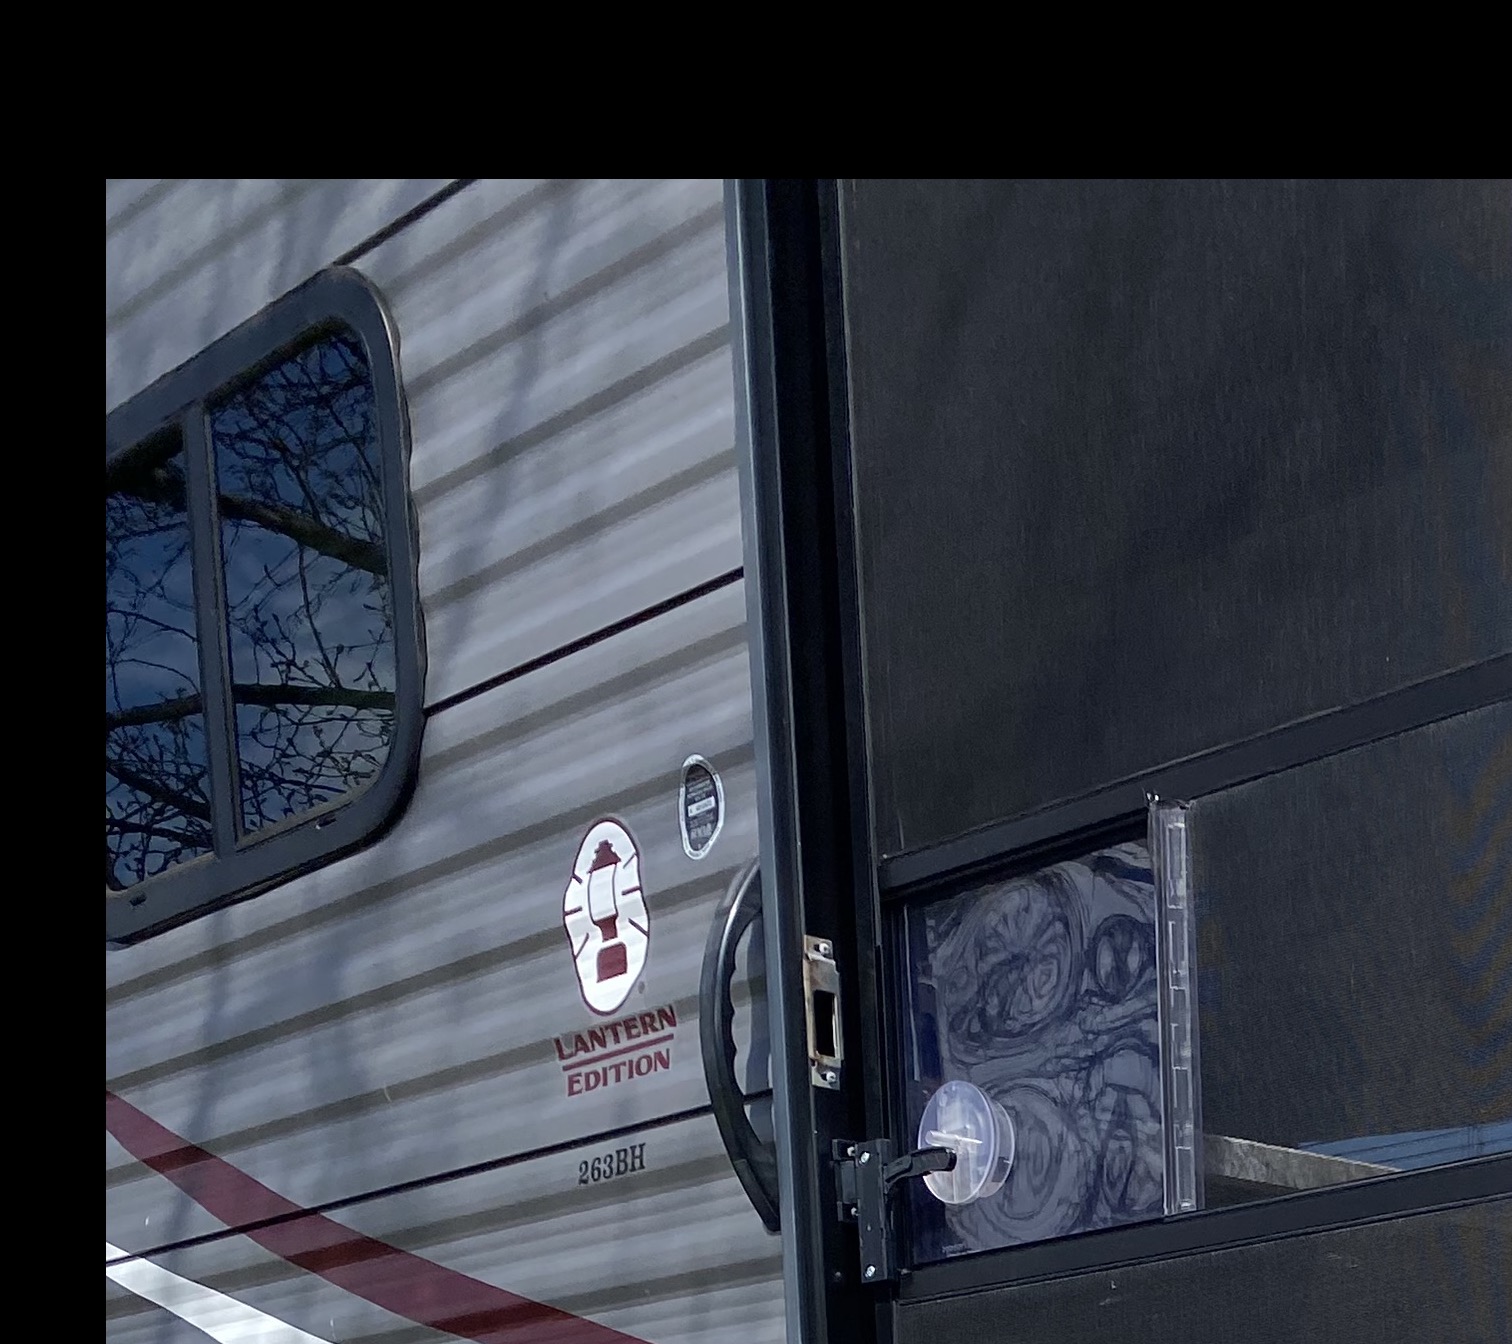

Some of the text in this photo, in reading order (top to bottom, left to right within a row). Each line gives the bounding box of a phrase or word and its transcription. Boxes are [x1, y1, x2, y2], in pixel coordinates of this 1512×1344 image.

[553, 1004, 677, 1061] LANTERN
[567, 1048, 671, 1097] EDITION
[578, 1142, 647, 1186] 263BH
